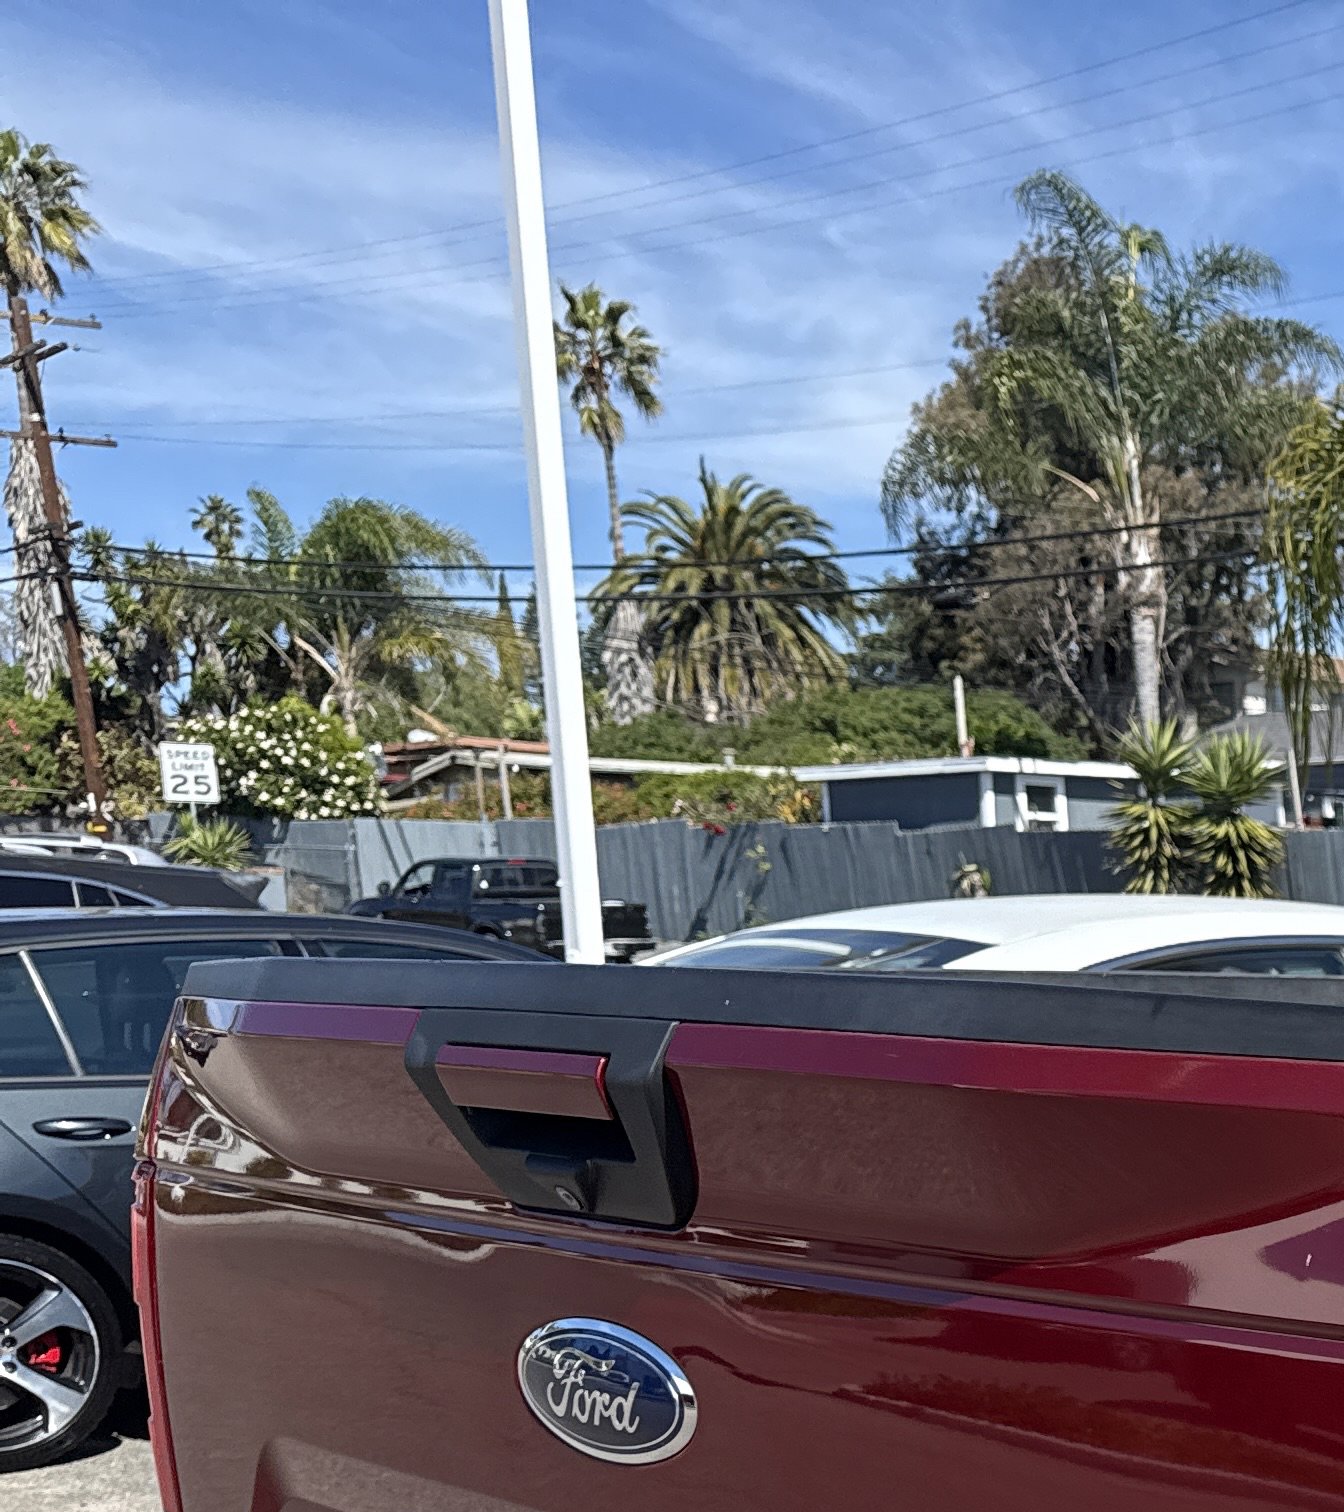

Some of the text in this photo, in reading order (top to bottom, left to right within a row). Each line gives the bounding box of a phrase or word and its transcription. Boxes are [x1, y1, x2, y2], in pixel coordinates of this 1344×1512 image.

[167, 749, 210, 760] SPEED
[171, 761, 205, 771] LIMIT
[170, 774, 211, 795] 25
[547, 1347, 640, 1433] Ford
